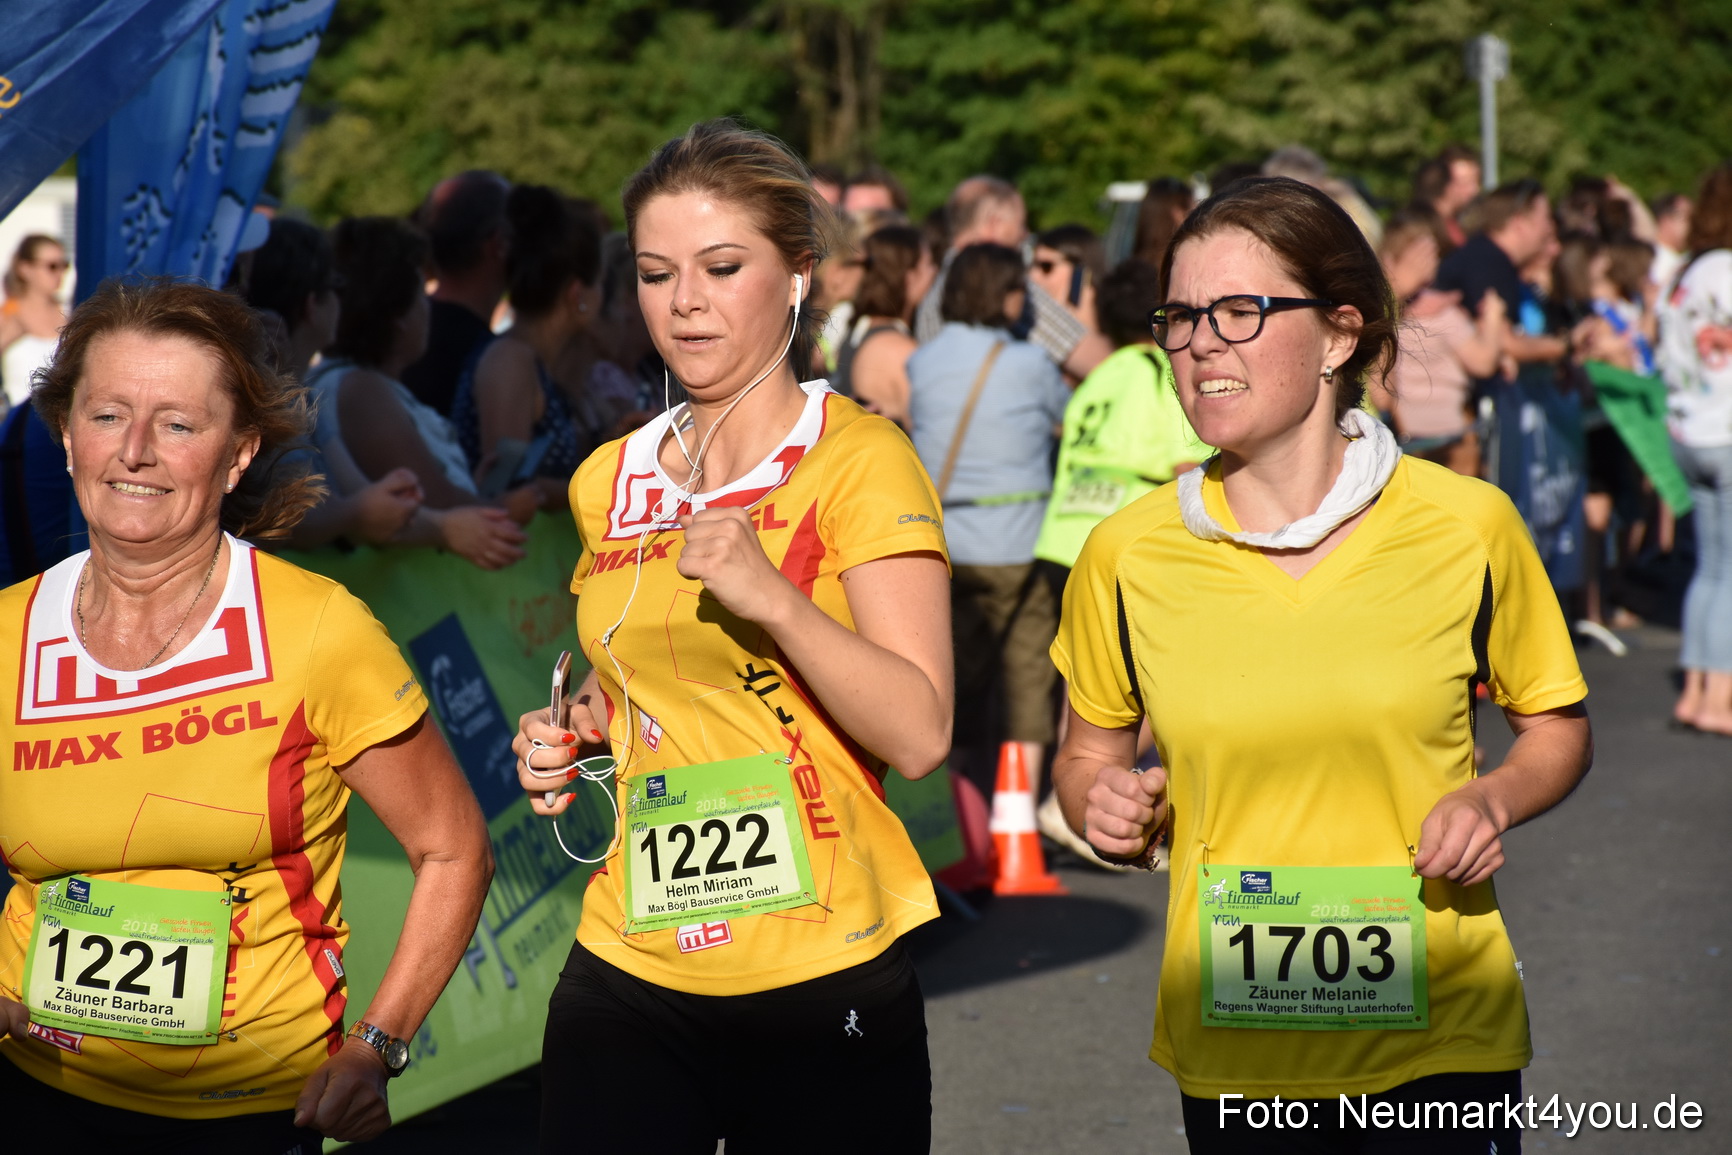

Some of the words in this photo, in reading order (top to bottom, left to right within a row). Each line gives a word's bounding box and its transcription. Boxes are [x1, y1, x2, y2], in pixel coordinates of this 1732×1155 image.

[588, 539, 677, 577] MAX
[13, 731, 123, 772] MAX
[142, 700, 278, 755] BÖGL
[639, 790, 687, 811] firmenlauf
[696, 797, 727, 812] 2018
[640, 813, 777, 883] 1222
[666, 882, 699, 898] Helm
[704, 876, 753, 892] Miriam
[1228, 890, 1301, 905] firmenlauf
[55, 894, 115, 917] firmenlauf
[648, 904, 665, 914] Max
[667, 900, 688, 911] Bögl
[690, 893, 744, 908] Bauservice
[746, 885, 779, 898] GmbH
[1310, 904, 1350, 917] 2018
[54, 907, 77, 916] neumarkt
[121, 919, 158, 934] 2018
[48, 927, 189, 999] 1221
[1229, 924, 1395, 983] 1703
[55, 986, 107, 1007] Zäuner
[112, 996, 173, 1015] Barbara
[1249, 986, 1307, 1001] Zäuner
[1312, 987, 1377, 1001] Melanie
[43, 1000, 61, 1012] Max
[64, 1005, 87, 1018] Bögl
[90, 1009, 148, 1025] Bauservice
[151, 1017, 185, 1028] GmbH
[1214, 1001, 1254, 1013] Regens
[1256, 1002, 1298, 1015] Wagner
[1301, 1003, 1344, 1015] Stiftung
[1347, 1003, 1414, 1013] Lauterhofen
